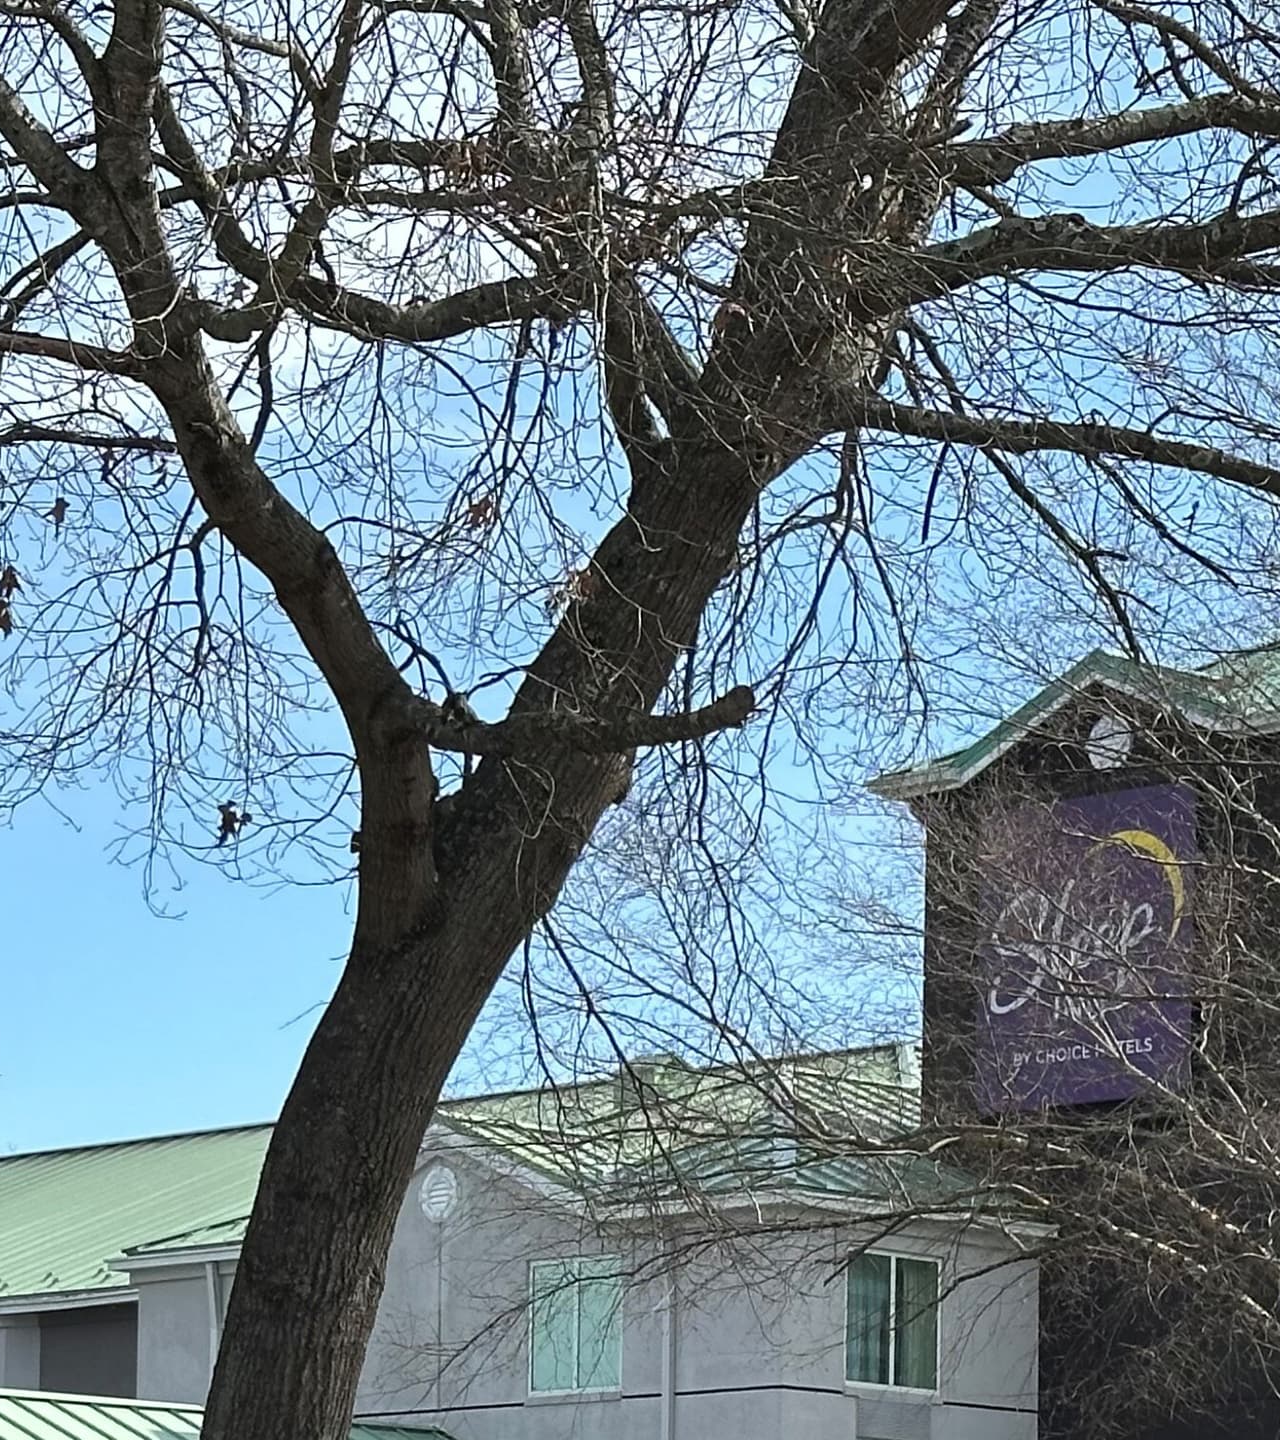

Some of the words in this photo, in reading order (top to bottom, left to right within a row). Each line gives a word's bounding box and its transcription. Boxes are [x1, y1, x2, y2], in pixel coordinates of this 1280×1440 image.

[1014, 1051, 1032, 1067] BY
[1036, 1045, 1091, 1064] CHOICE
[1094, 1037, 1153, 1059] TELS
